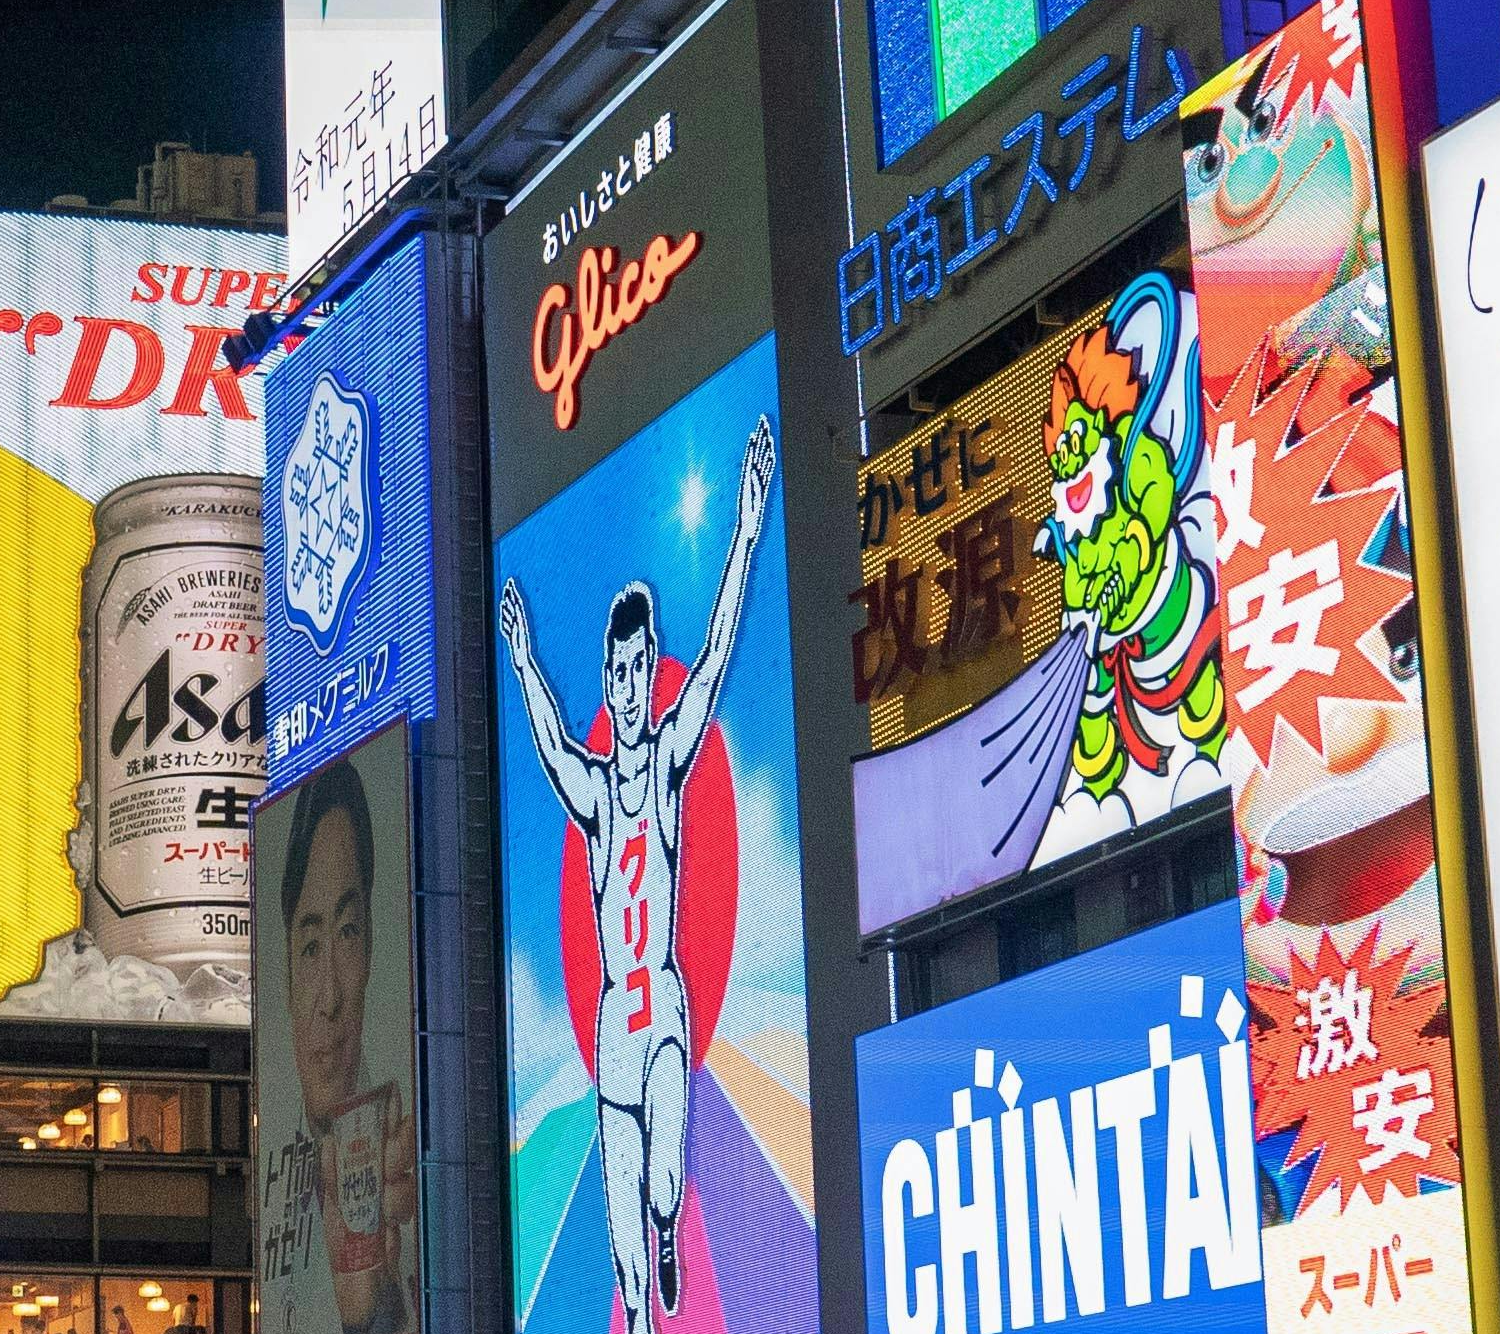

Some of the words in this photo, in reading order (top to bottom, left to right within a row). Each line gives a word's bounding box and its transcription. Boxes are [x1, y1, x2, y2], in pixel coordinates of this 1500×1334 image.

[290, 60, 396, 217] 令和元年
[341, 94, 438, 232] 5月14日
[542, 111, 673, 263] おいしさと健康
[835, 25, 1187, 357] 日商エステム
[532, 232, 704, 431] Glico
[858, 417, 998, 552] かぜに
[137, 585, 172, 625] ASAHI
[178, 569, 262, 600] BREWERIES
[272, 647, 391, 763] 雪印メグミルク
[619, 820, 651, 1036] グリコ
[1296, 968, 1434, 1174] 激安
[1297, 1234, 1433, 1320] スーパー
